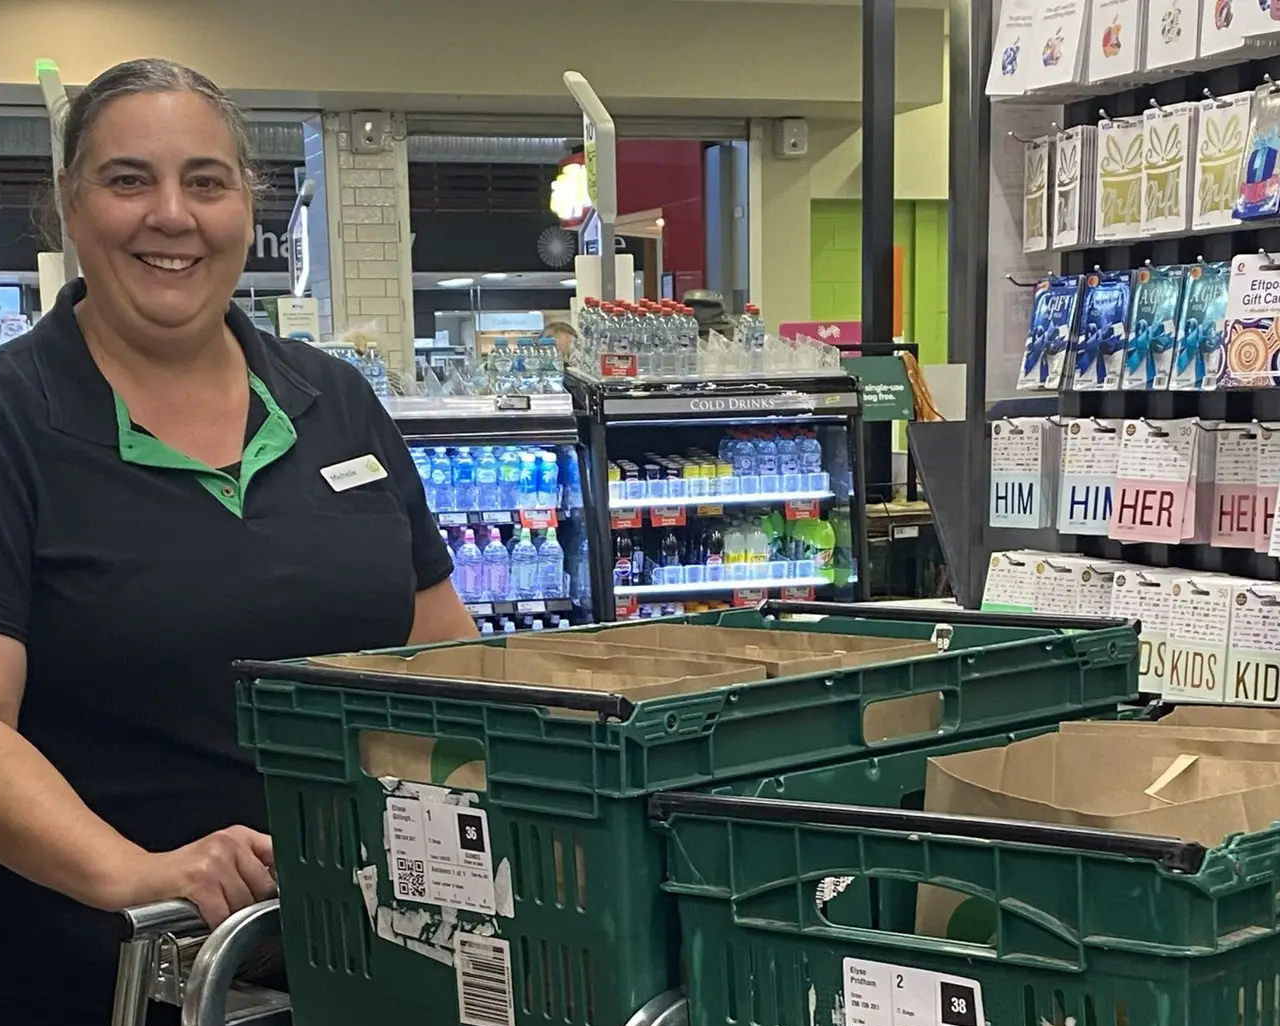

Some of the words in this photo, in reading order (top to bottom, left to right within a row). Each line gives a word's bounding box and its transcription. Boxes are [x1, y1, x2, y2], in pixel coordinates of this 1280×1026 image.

[1101, 122, 1113, 130] VISA
[1242, 294, 1261, 306] Gift
[865, 384, 904, 393] single-use
[690, 399, 725, 411] COLD
[728, 398, 775, 409] DRINKS
[863, 394, 878, 402] bag
[878, 393, 896, 401] free.
[996, 482, 1034, 515] HIM
[1118, 489, 1174, 528] HER
[1170, 649, 1217, 690] KIDS
[1235, 661, 1279, 701] KID
[425, 808, 431, 821] 1
[464, 825, 477, 840] 36
[895, 973, 904, 989] 2
[949, 996, 967, 1014] 38
